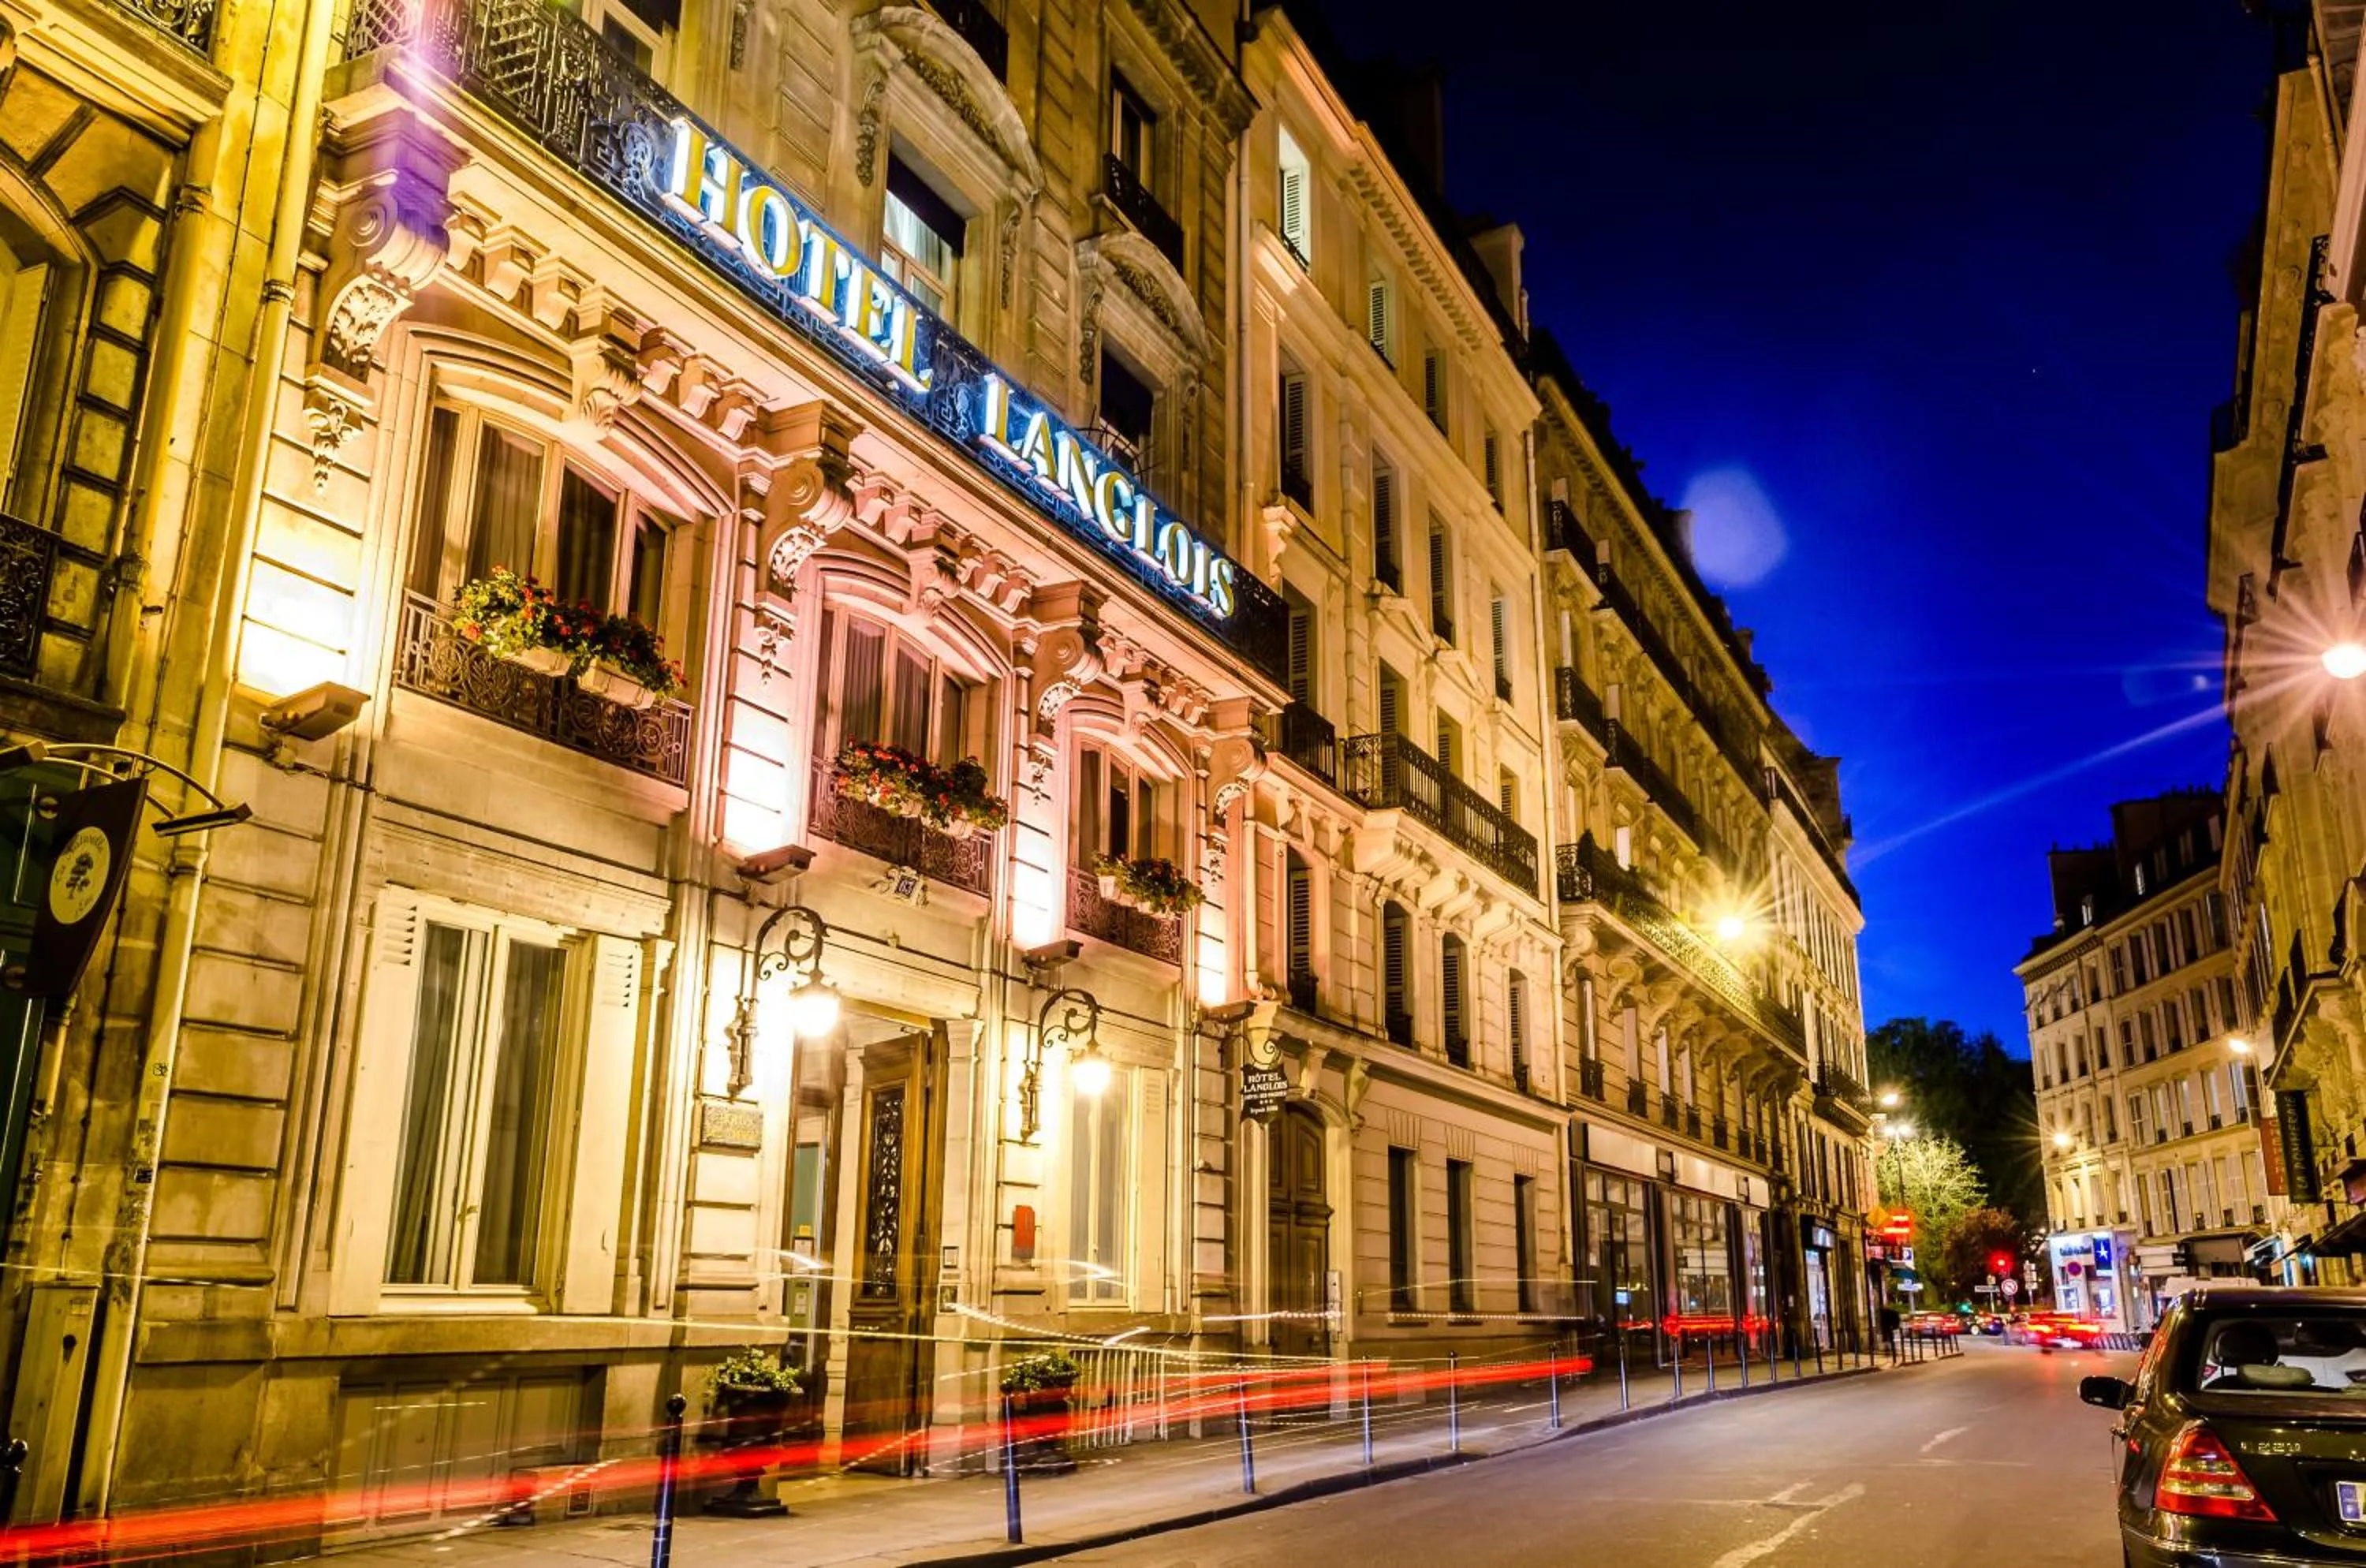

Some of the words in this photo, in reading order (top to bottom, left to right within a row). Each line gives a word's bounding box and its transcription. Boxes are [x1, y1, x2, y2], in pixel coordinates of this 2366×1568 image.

[662, 116, 933, 392] HOTEL
[980, 374, 1235, 619] LANGLOIS
[1244, 1081, 1287, 1093] LANGLOIS
